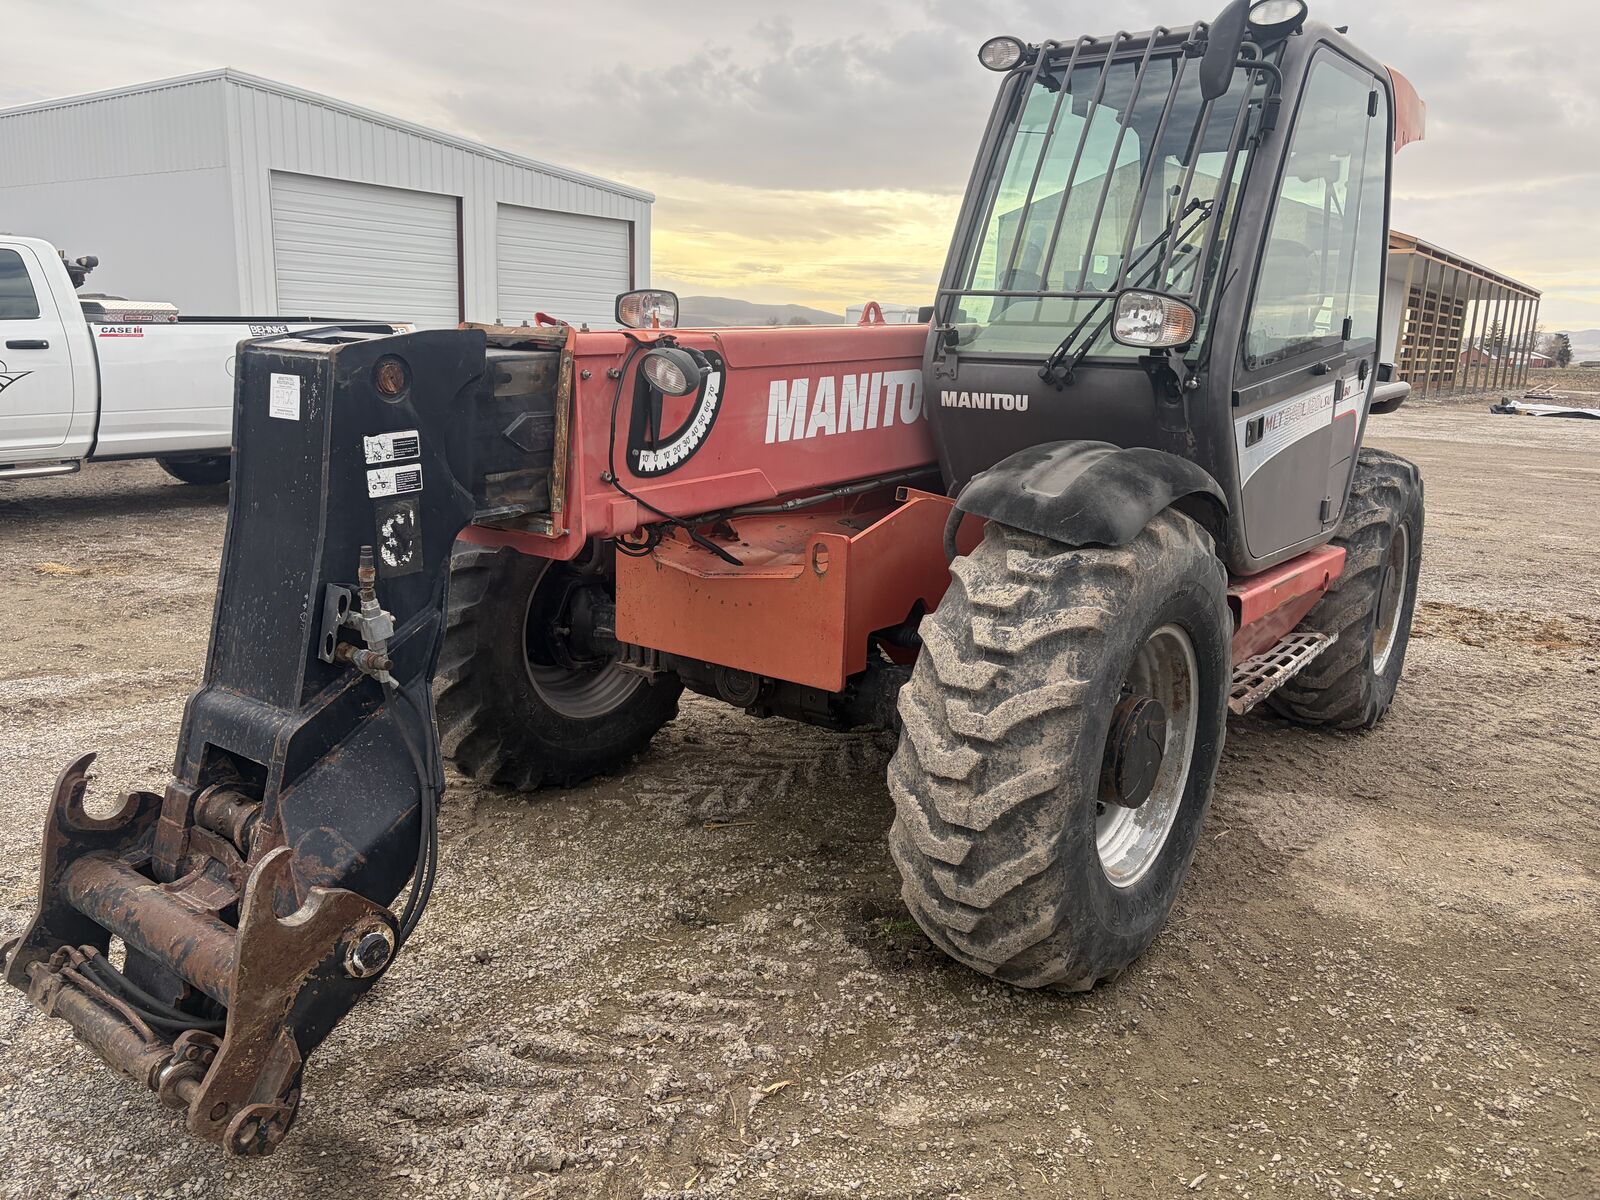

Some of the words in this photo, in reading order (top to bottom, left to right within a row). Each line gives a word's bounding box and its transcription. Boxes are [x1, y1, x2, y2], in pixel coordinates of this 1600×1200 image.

[250, 325, 286, 334] BEHNKE
[765, 369, 927, 444] MANITO
[941, 390, 1029, 412] MANITOU
